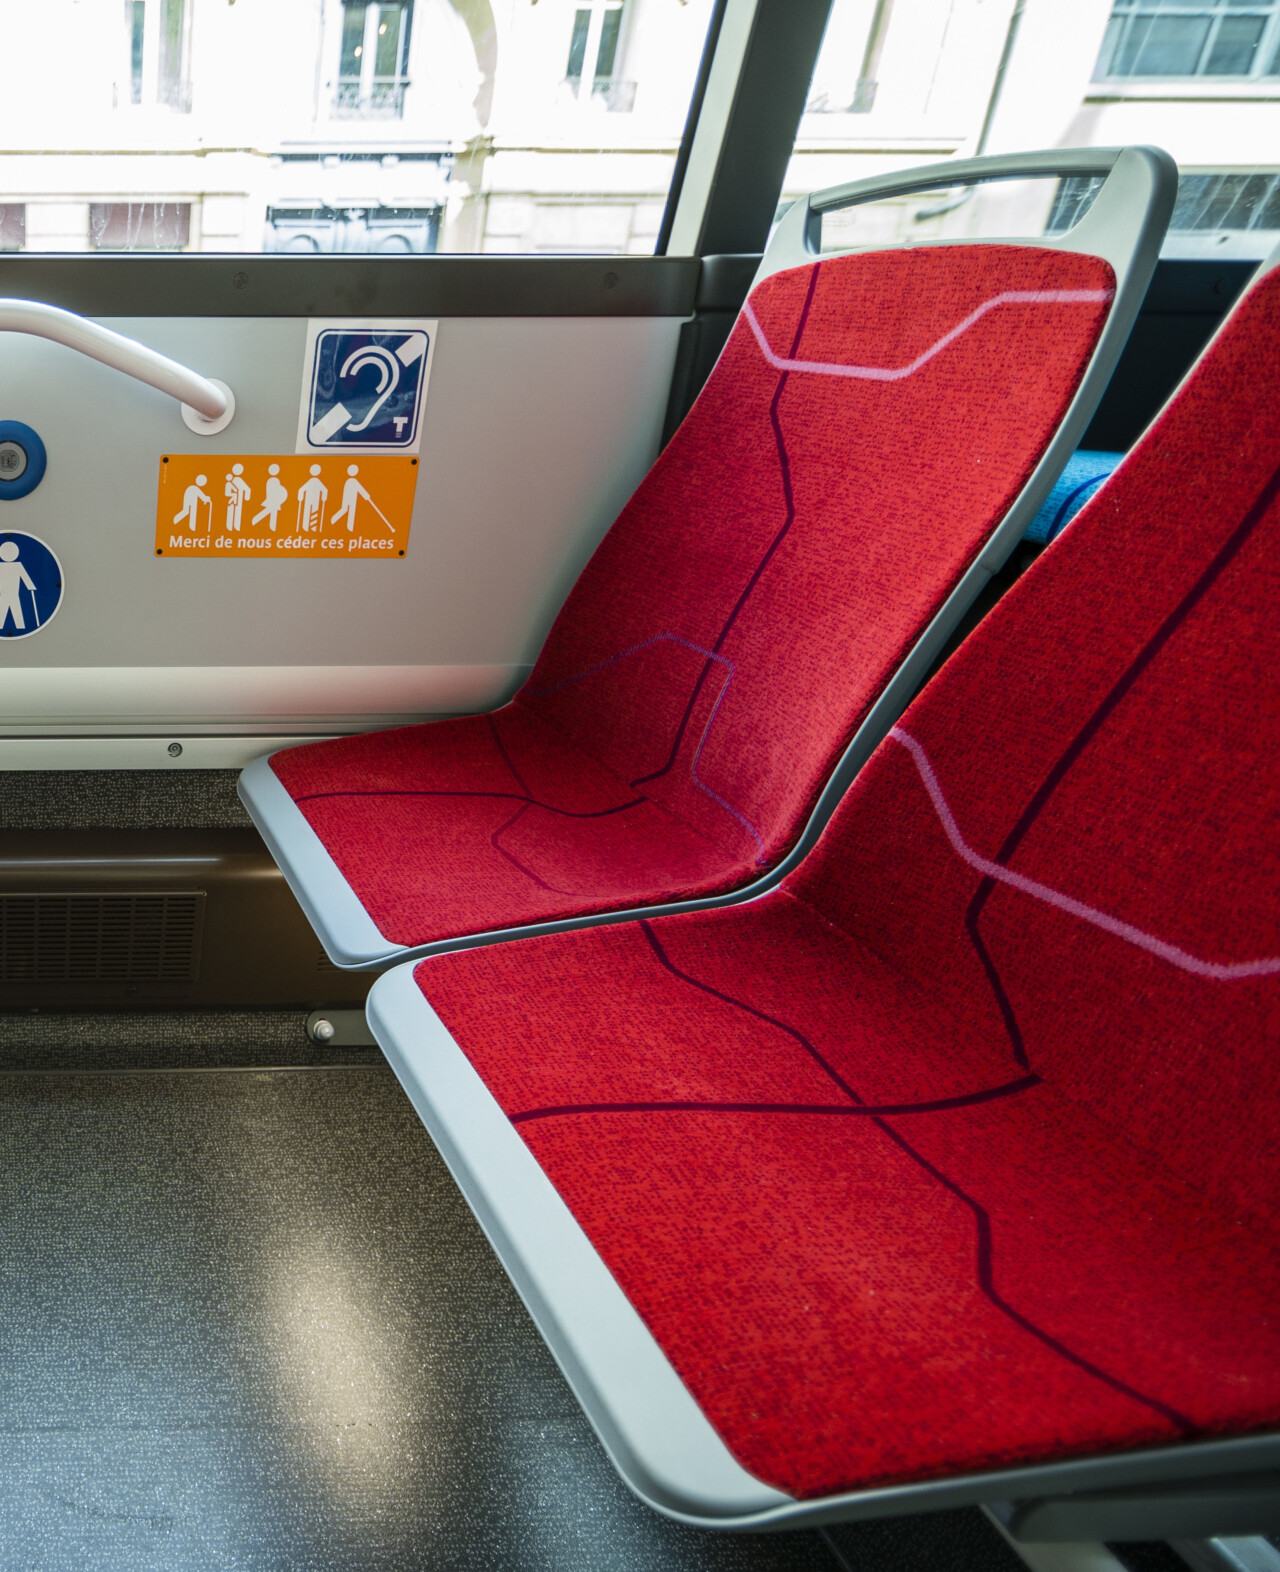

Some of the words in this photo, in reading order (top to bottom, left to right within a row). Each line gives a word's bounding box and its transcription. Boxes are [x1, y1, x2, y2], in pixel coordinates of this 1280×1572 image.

[169, 535, 210, 548] Merci
[214, 535, 233, 549] de
[237, 538, 271, 549] nous
[276, 535, 317, 549] céder
[320, 538, 344, 549] ces
[348, 536, 394, 552] places
